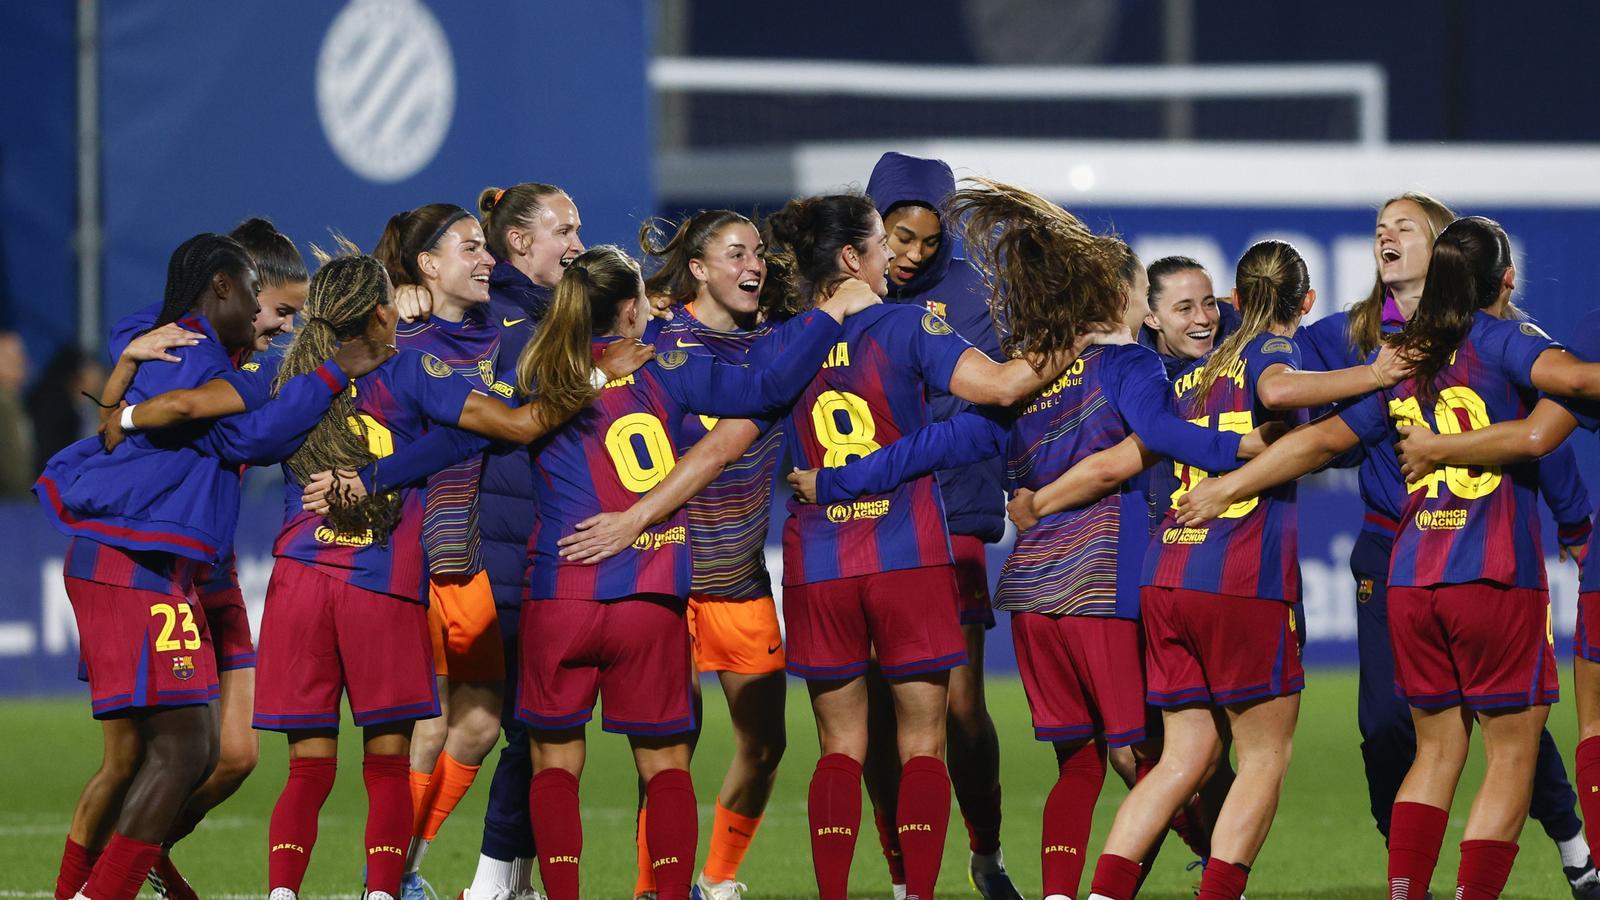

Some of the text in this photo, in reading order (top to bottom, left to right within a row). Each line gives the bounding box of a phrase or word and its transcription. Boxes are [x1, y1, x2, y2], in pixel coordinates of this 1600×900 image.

[852, 499, 890, 511] UNHCR
[853, 507, 889, 519] ACNUR
[1432, 509, 1467, 518] UNHCR
[1430, 517, 1467, 527] ACNUR
[150, 602, 201, 652] 23
